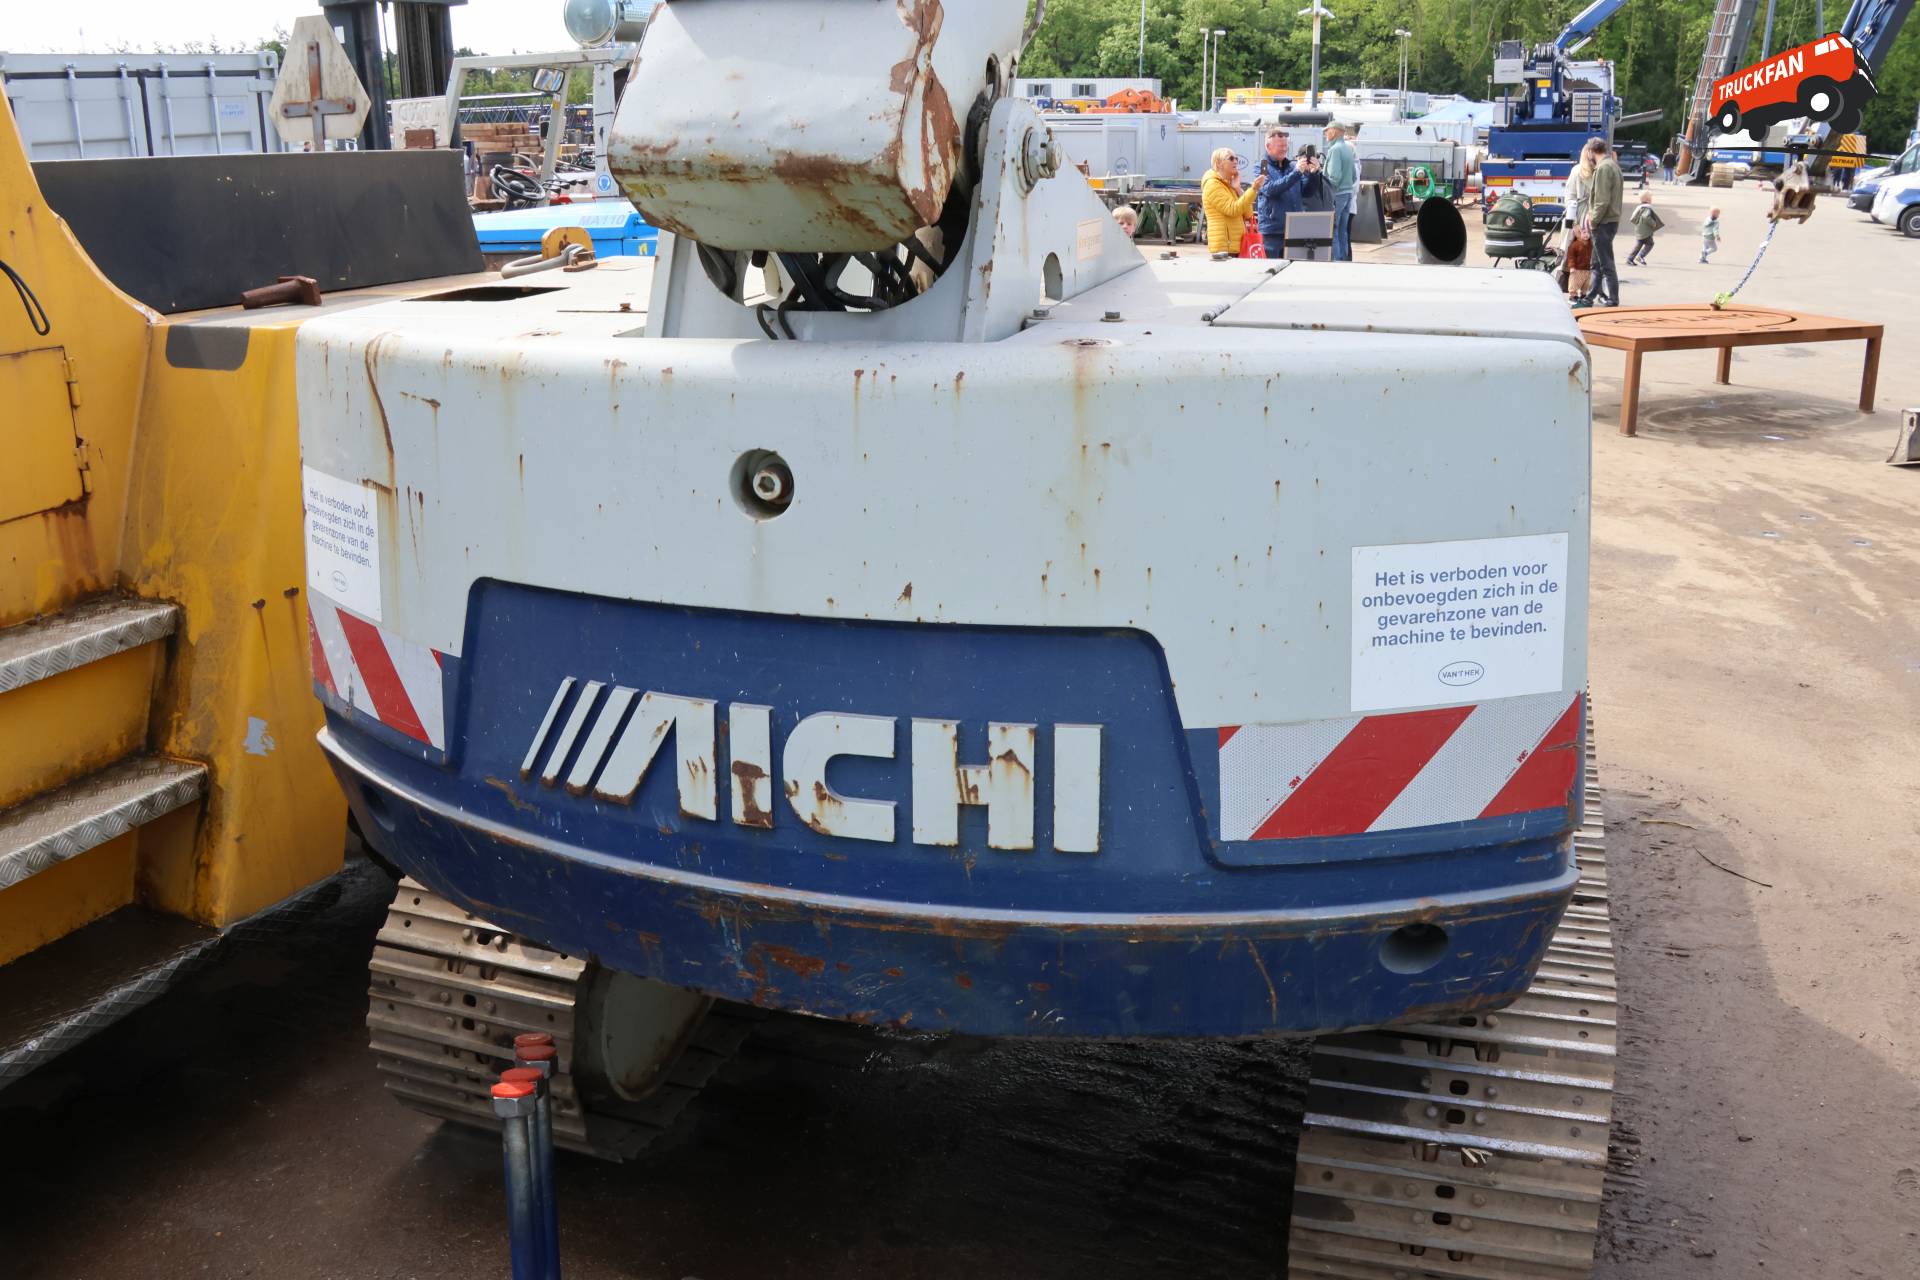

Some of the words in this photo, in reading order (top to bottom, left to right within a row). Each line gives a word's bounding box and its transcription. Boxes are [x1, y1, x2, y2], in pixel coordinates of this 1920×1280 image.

[307, 502, 342, 526] onbevoegden
[343, 518, 356, 533] zich
[357, 522, 365, 534] in
[365, 525, 375, 538] de
[309, 487, 319, 500] Het
[325, 495, 353, 514] verboden
[353, 507, 369, 520] voor
[311, 534, 333, 551] machine
[333, 543, 340, 555] te
[340, 545, 372, 568] bevinden.
[312, 519, 346, 542] gevarenzone
[347, 535, 359, 547] van
[360, 538, 369, 552] de
[1375, 571, 1405, 587] Het
[1411, 570, 1424, 585] is
[1430, 564, 1507, 584] verboden
[1512, 562, 1548, 577] voor
[1361, 587, 1478, 608] onbevoegden
[1482, 582, 1515, 599] zich
[1520, 581, 1534, 596] in
[1538, 579, 1558, 594] de
[1377, 607, 1486, 630] gevarenzone
[1491, 604, 1519, 618] van
[1524, 600, 1543, 615] de
[1372, 629, 1445, 647] machine
[1450, 626, 1466, 641] te
[1470, 620, 1548, 640] bevinden.
[520, 676, 1104, 853] AICHI
